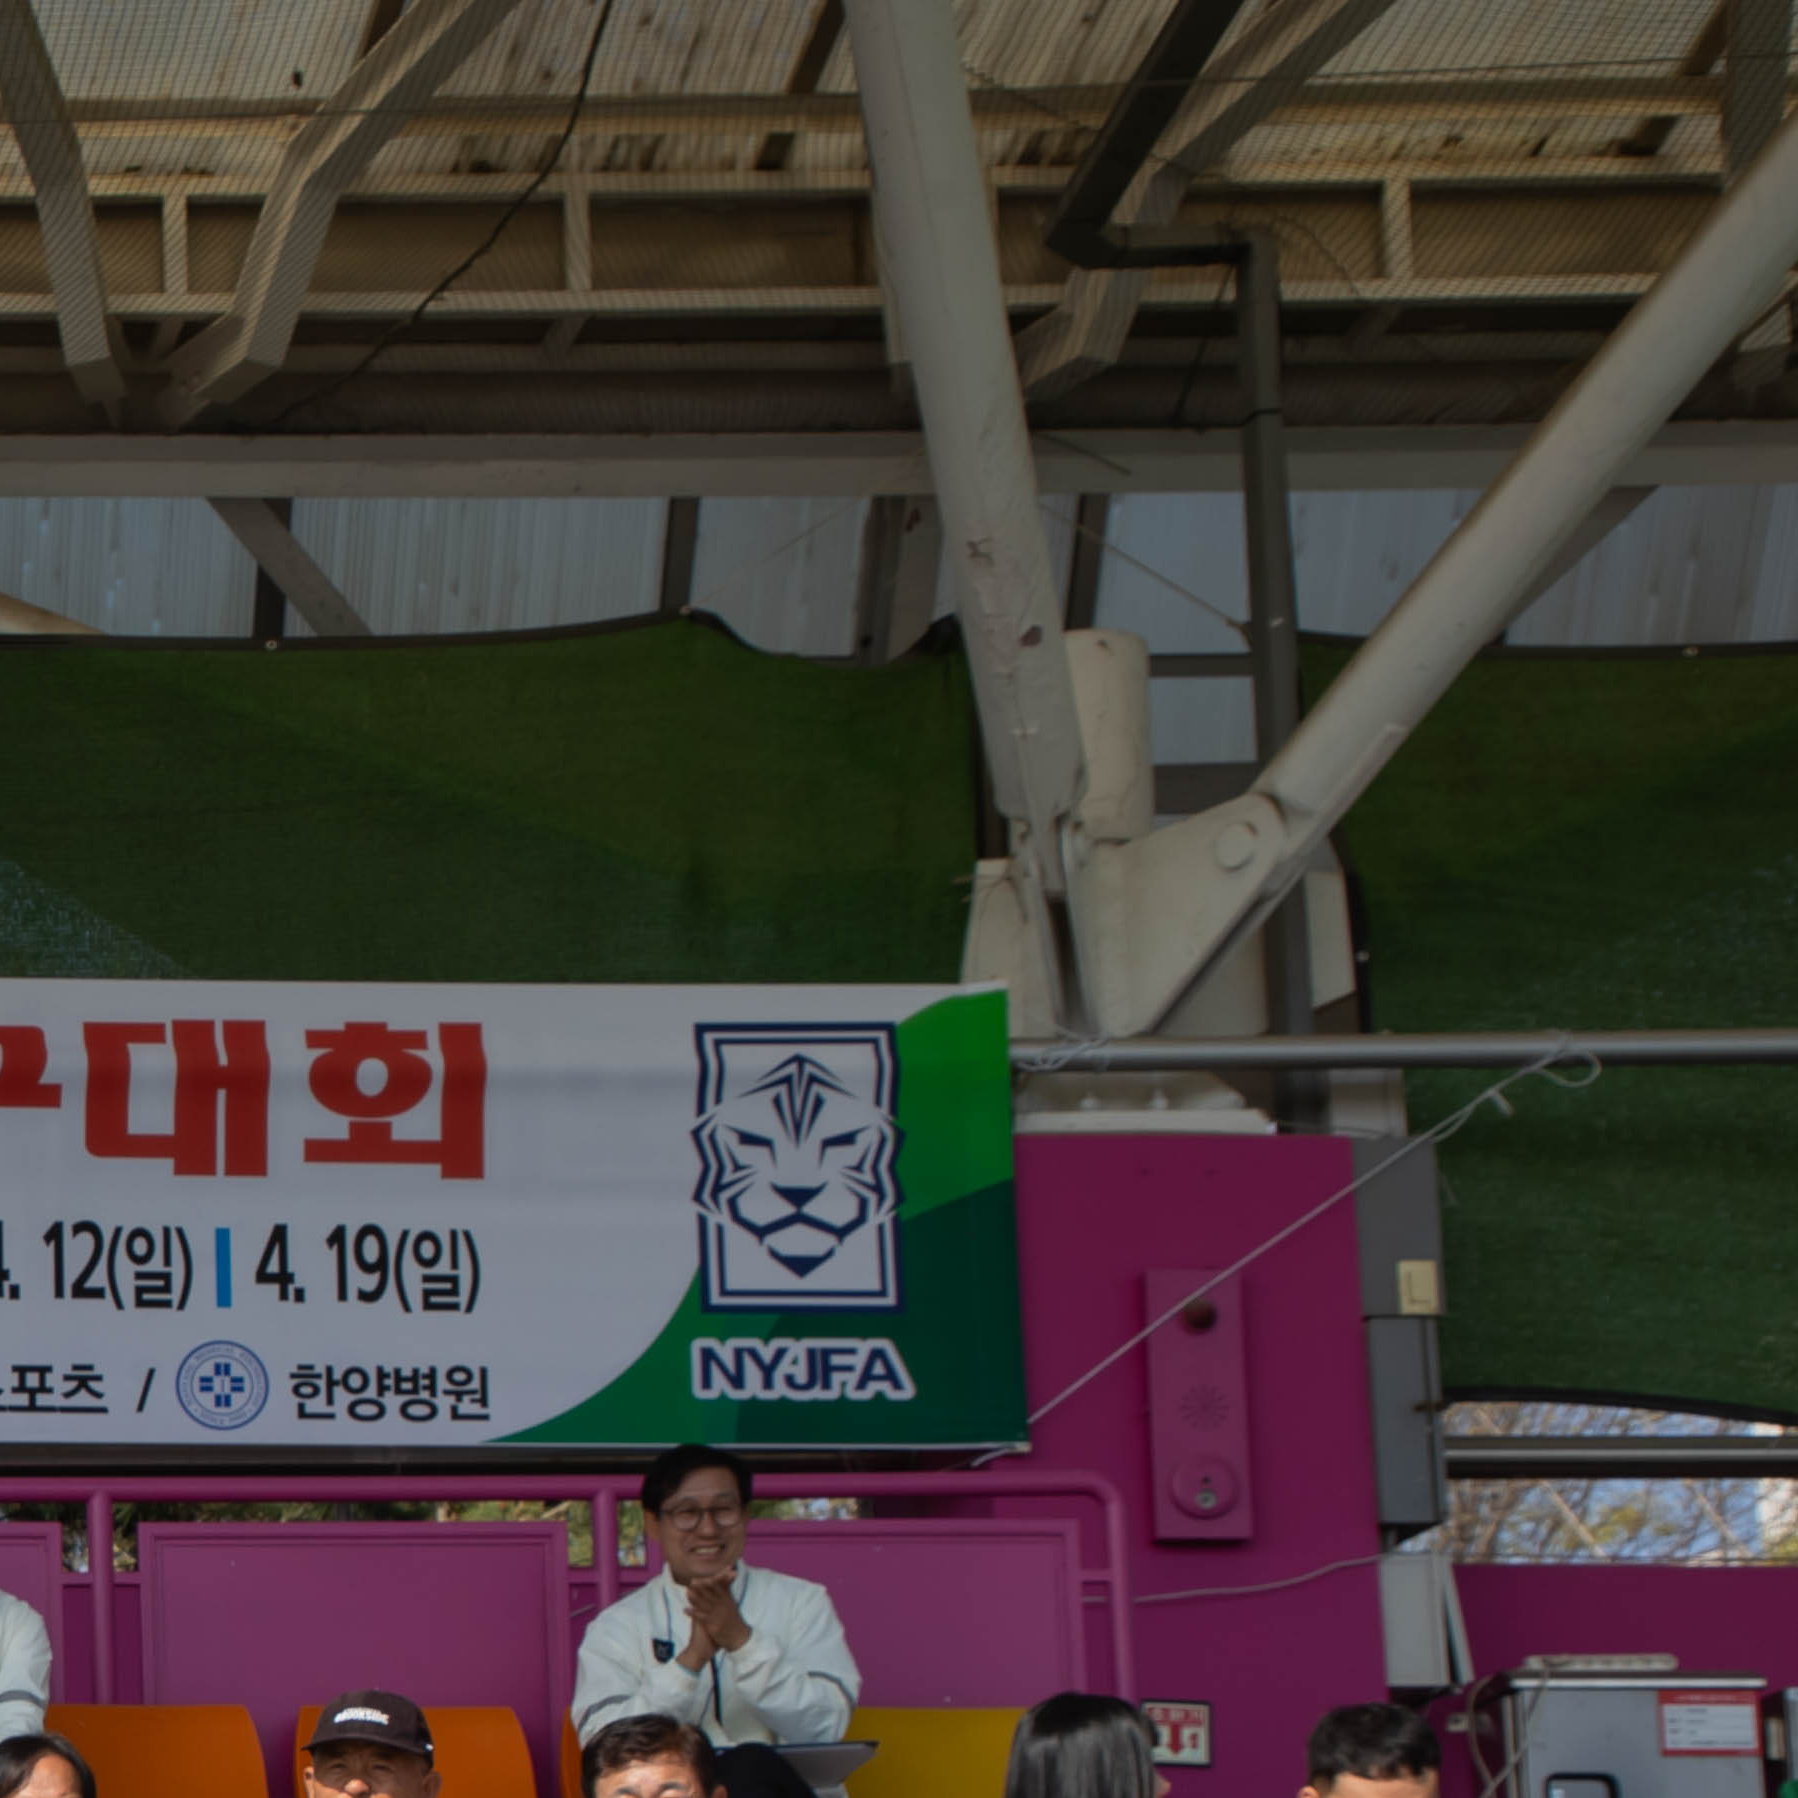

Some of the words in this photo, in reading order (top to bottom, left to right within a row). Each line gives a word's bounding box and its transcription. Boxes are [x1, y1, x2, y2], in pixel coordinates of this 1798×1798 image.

[42, 1220, 193, 1311] 12(일)
[255, 1223, 305, 1303] 4.
[325, 1223, 480, 1314] 19(일)
[288, 1363, 491, 1422] 한양병원
[698, 1345, 907, 1392] NYJFA
